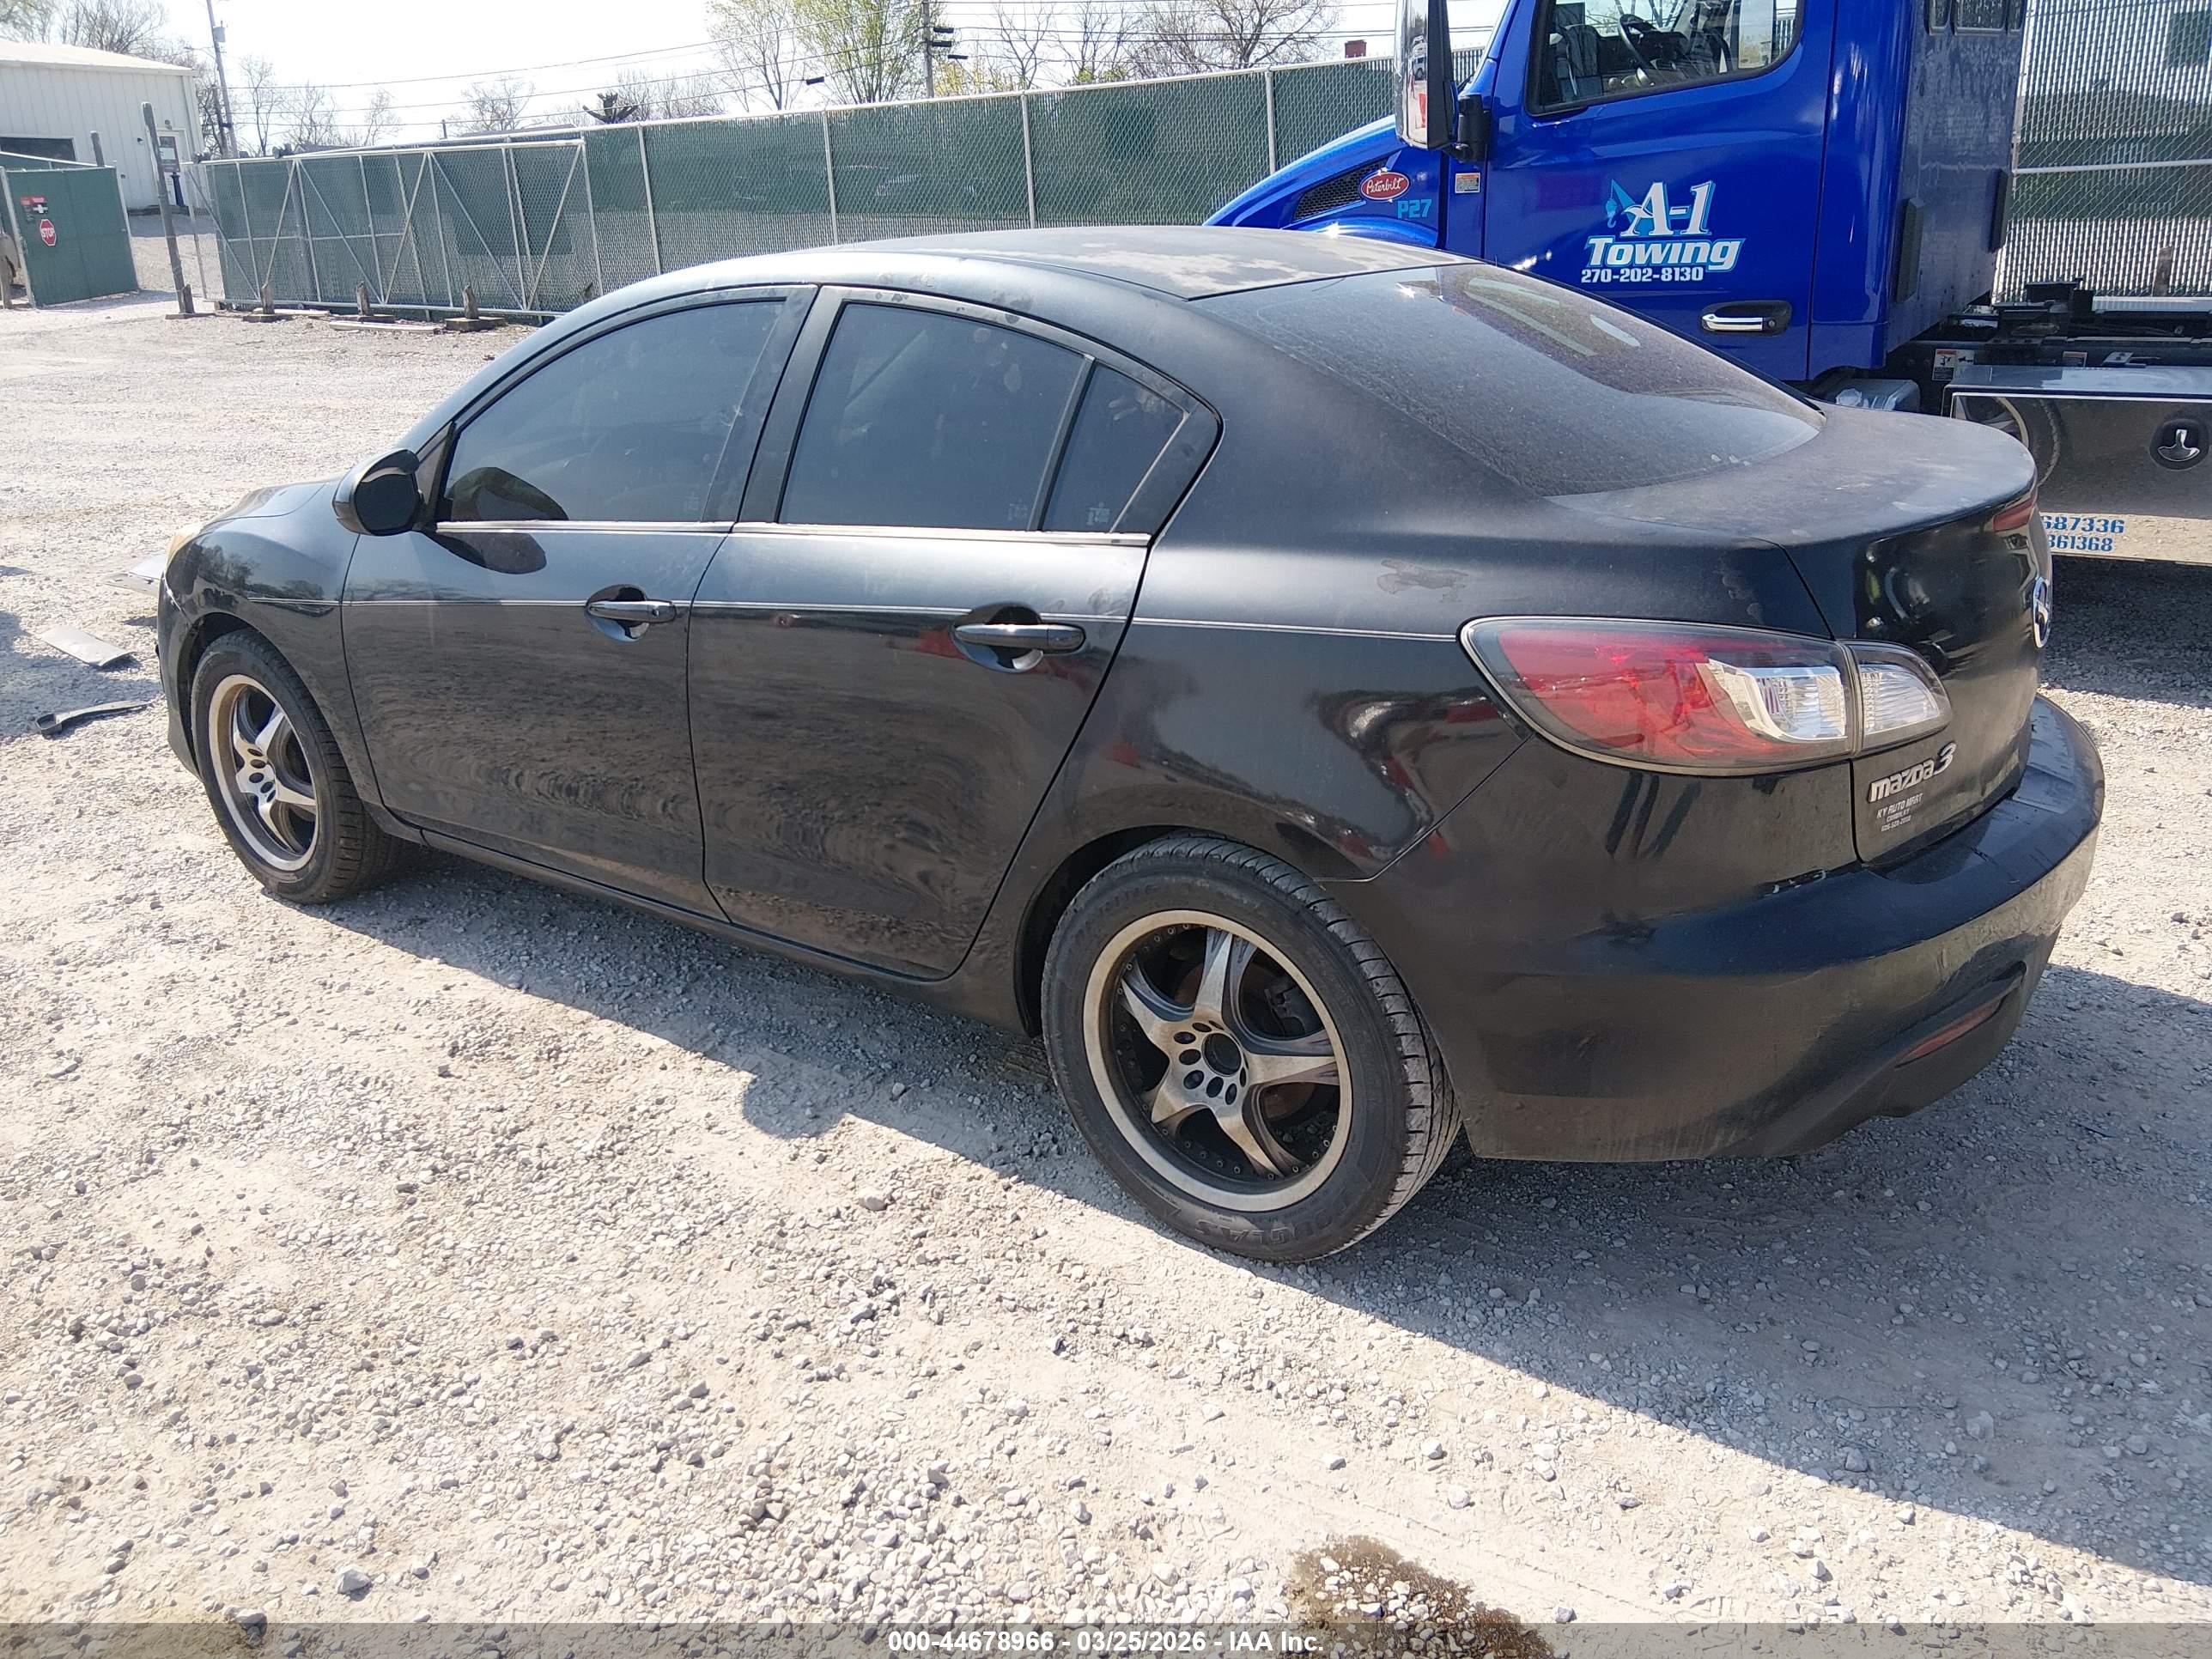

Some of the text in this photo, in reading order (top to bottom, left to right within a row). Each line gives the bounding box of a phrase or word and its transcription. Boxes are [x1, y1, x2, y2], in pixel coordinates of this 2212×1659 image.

[1366, 177, 1405, 195] Peterbilt
[1397, 198, 1432, 219] P27
[1620, 179, 1715, 237] A-1
[1587, 236, 1743, 271] Towing
[1581, 266, 1704, 283] 270-202-8130
